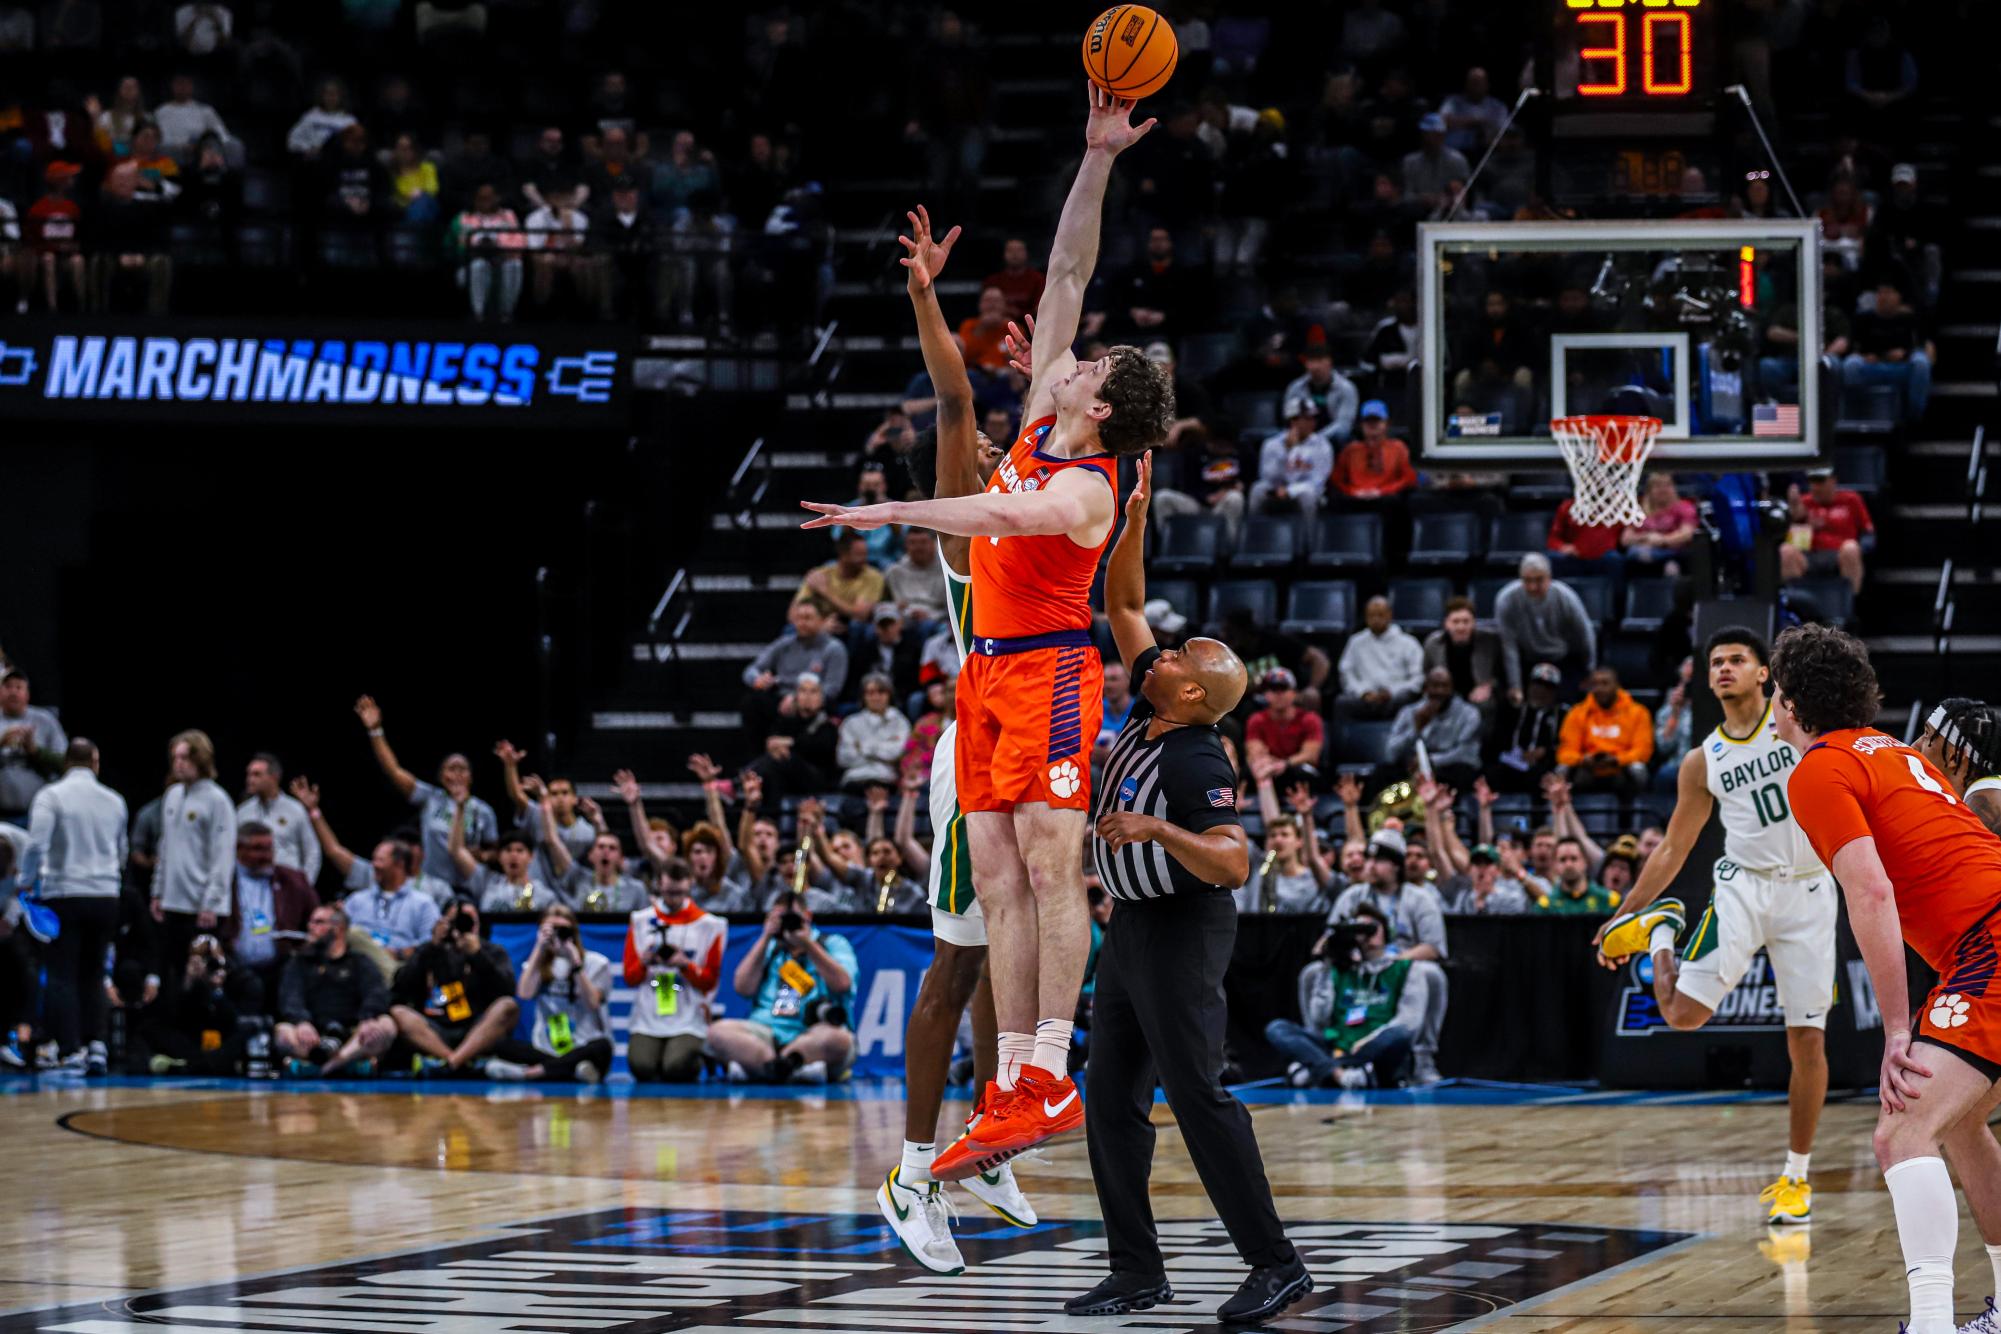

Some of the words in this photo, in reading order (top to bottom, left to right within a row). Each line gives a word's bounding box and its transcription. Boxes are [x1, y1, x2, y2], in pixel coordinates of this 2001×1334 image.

[1577, 11, 1692, 96] 30
[984, 638, 994, 655] C
[1720, 745, 1796, 793] BAYLOR
[1750, 781, 1790, 828] 10
